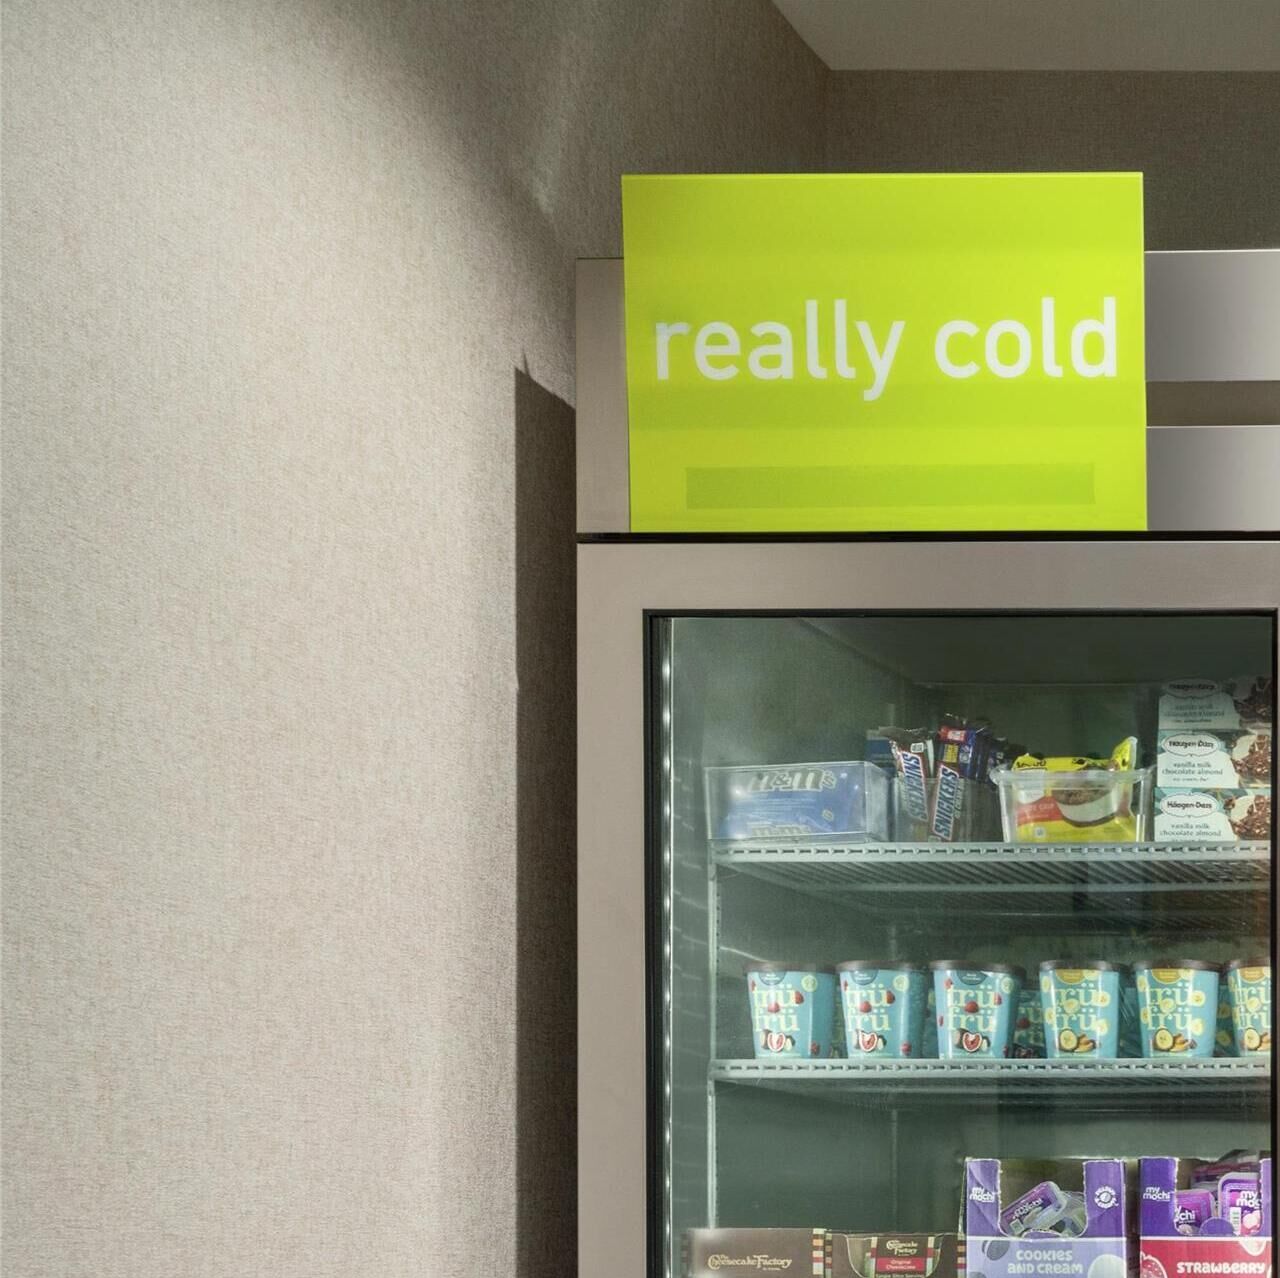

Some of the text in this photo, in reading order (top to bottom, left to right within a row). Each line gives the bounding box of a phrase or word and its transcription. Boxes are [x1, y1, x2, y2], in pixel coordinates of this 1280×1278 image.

[654, 296, 1119, 401] really cold
[934, 765, 959, 839] SNICKERS
[1143, 1191, 1171, 1199] mochi
[1146, 1187, 1159, 1196] my
[708, 1255, 792, 1270] Cheesecake Factory
